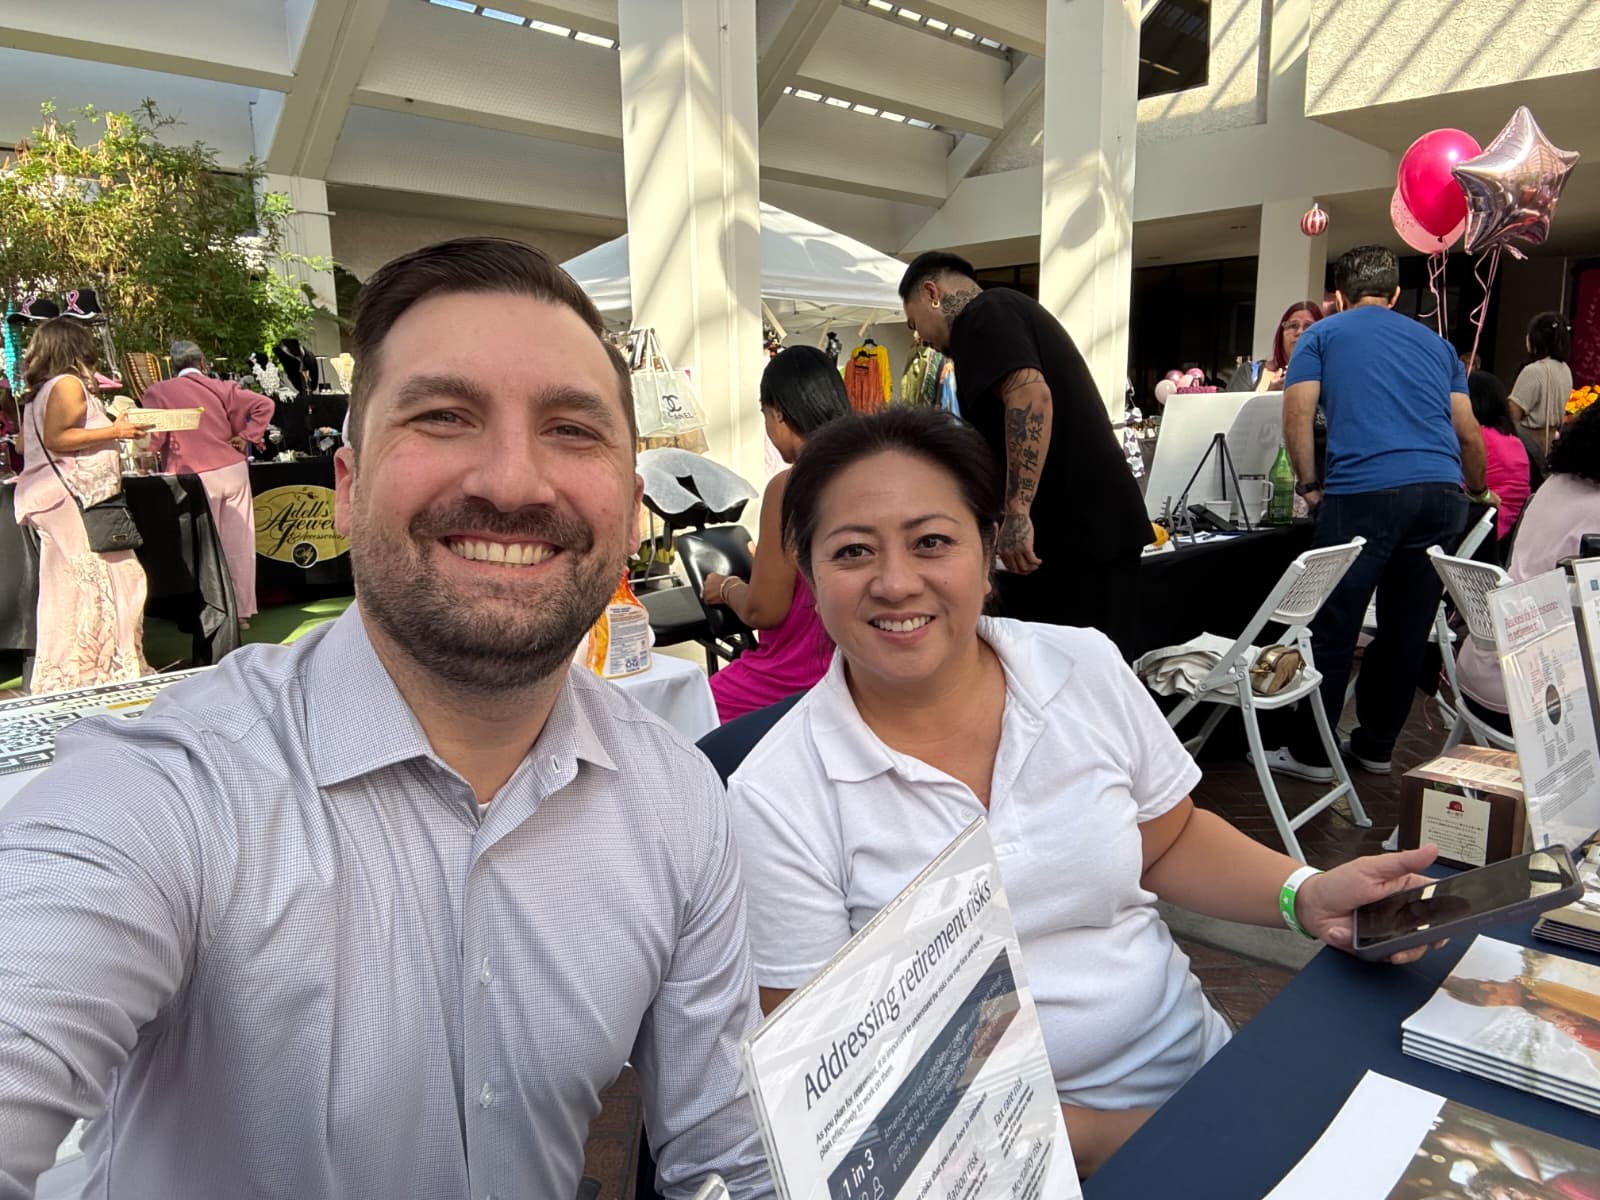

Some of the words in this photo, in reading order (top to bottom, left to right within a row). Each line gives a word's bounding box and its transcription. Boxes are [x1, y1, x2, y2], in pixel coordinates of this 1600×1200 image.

[804, 986, 900, 1111] Addressing
[898, 907, 967, 1000] retirement
[966, 879, 991, 921] risks
[815, 1130, 824, 1144] As
[823, 1118, 834, 1136] you
[833, 1104, 845, 1124] plan
[844, 1095, 852, 1108] for
[905, 1024, 911, 1032] to
[993, 1107, 1004, 1127] Tax
[1003, 1090, 1013, 1113] rate
[1012, 1076, 1022, 1096] risk
[819, 1140, 832, 1160] plan
[831, 1109, 857, 1144] effectively
[856, 1101, 863, 1112] to
[883, 1104, 907, 1140] American
[842, 1178, 851, 1198] 1
[851, 1164, 865, 1188] in
[864, 1148, 874, 1170] 3
[931, 1163, 941, 1181] that
[940, 1153, 949, 1170] you
[948, 1139, 957, 1156] may
[956, 1126, 965, 1142] face
[966, 1151, 979, 1174] risk
[1011, 1153, 1033, 1196] Mortality
[1032, 1136, 1042, 1158] risk
